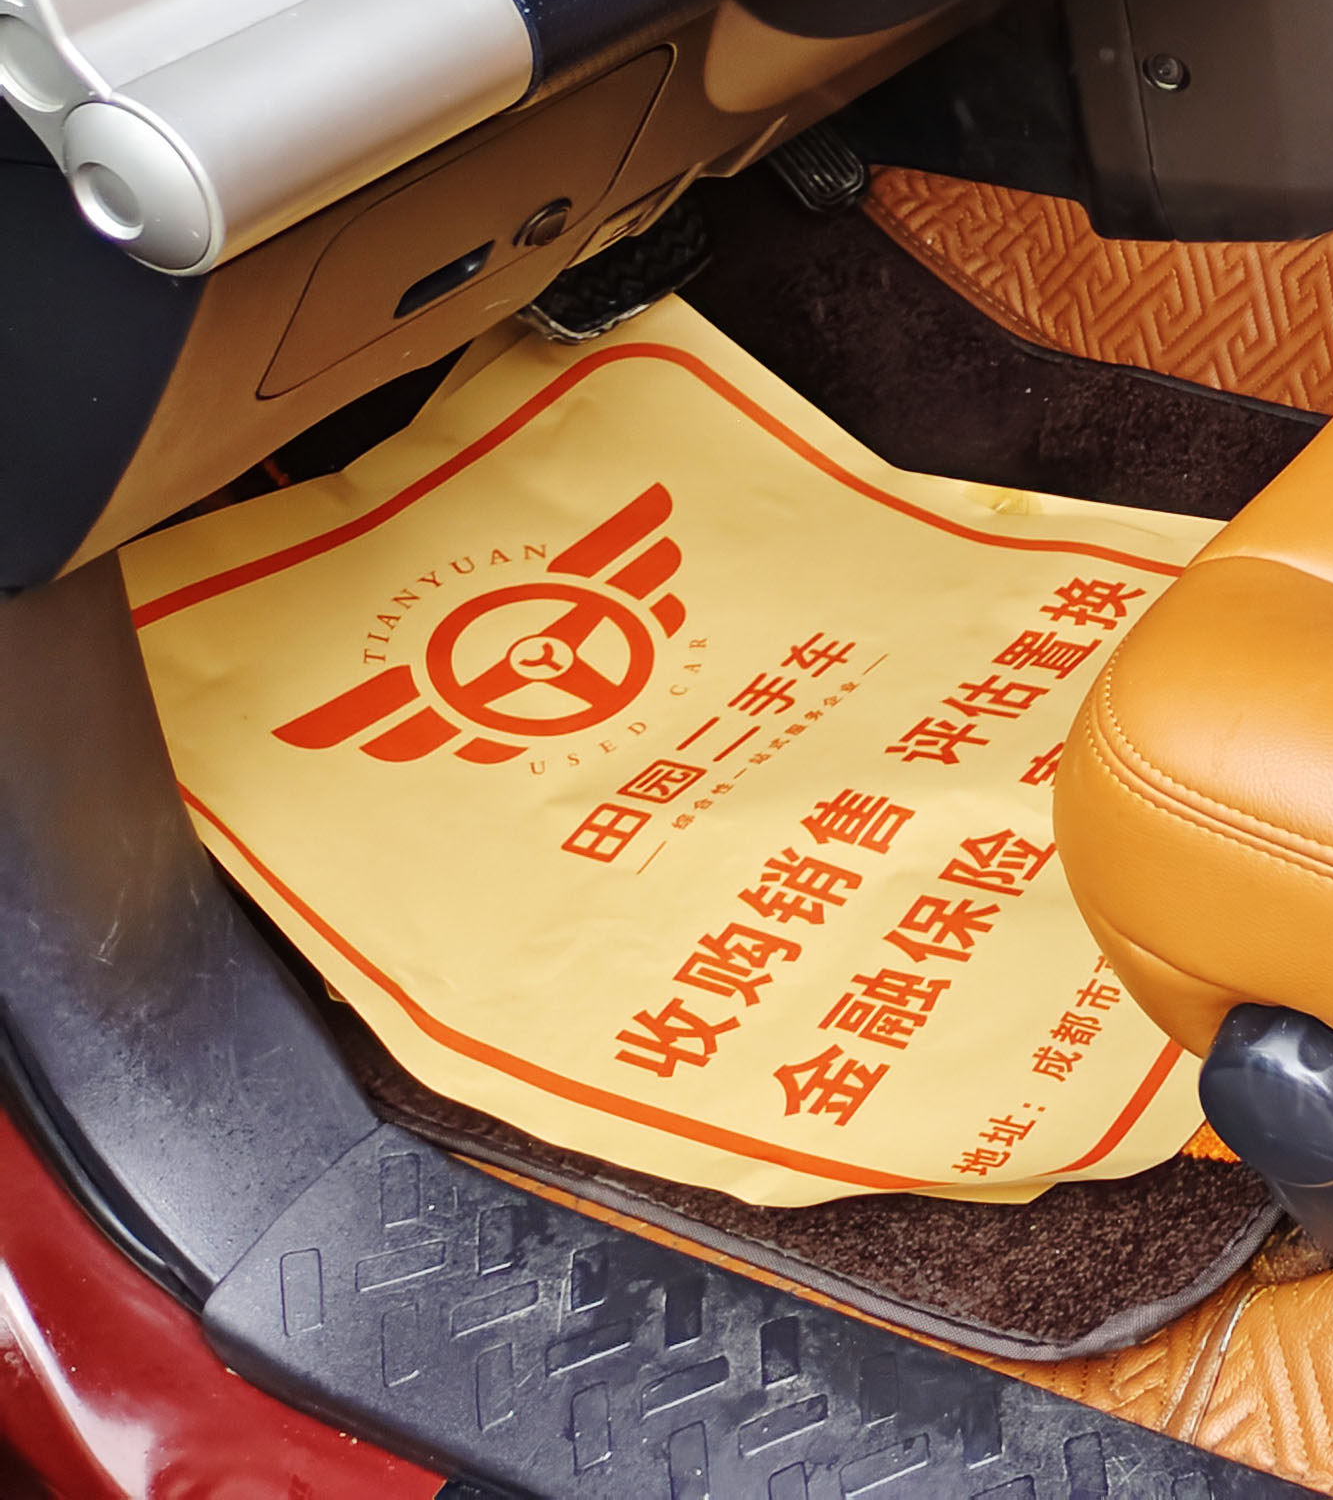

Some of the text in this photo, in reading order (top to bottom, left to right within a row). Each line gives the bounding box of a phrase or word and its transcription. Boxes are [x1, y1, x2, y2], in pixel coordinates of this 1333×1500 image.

[363, 543, 549, 666] TIANYUAN
[529, 636, 708, 776] USED CAR
[561, 631, 857, 864] 田园二手车
[614, 576, 1147, 1079] 收购销售 评估置换
[772, 827, 1056, 1128] 金融保险
